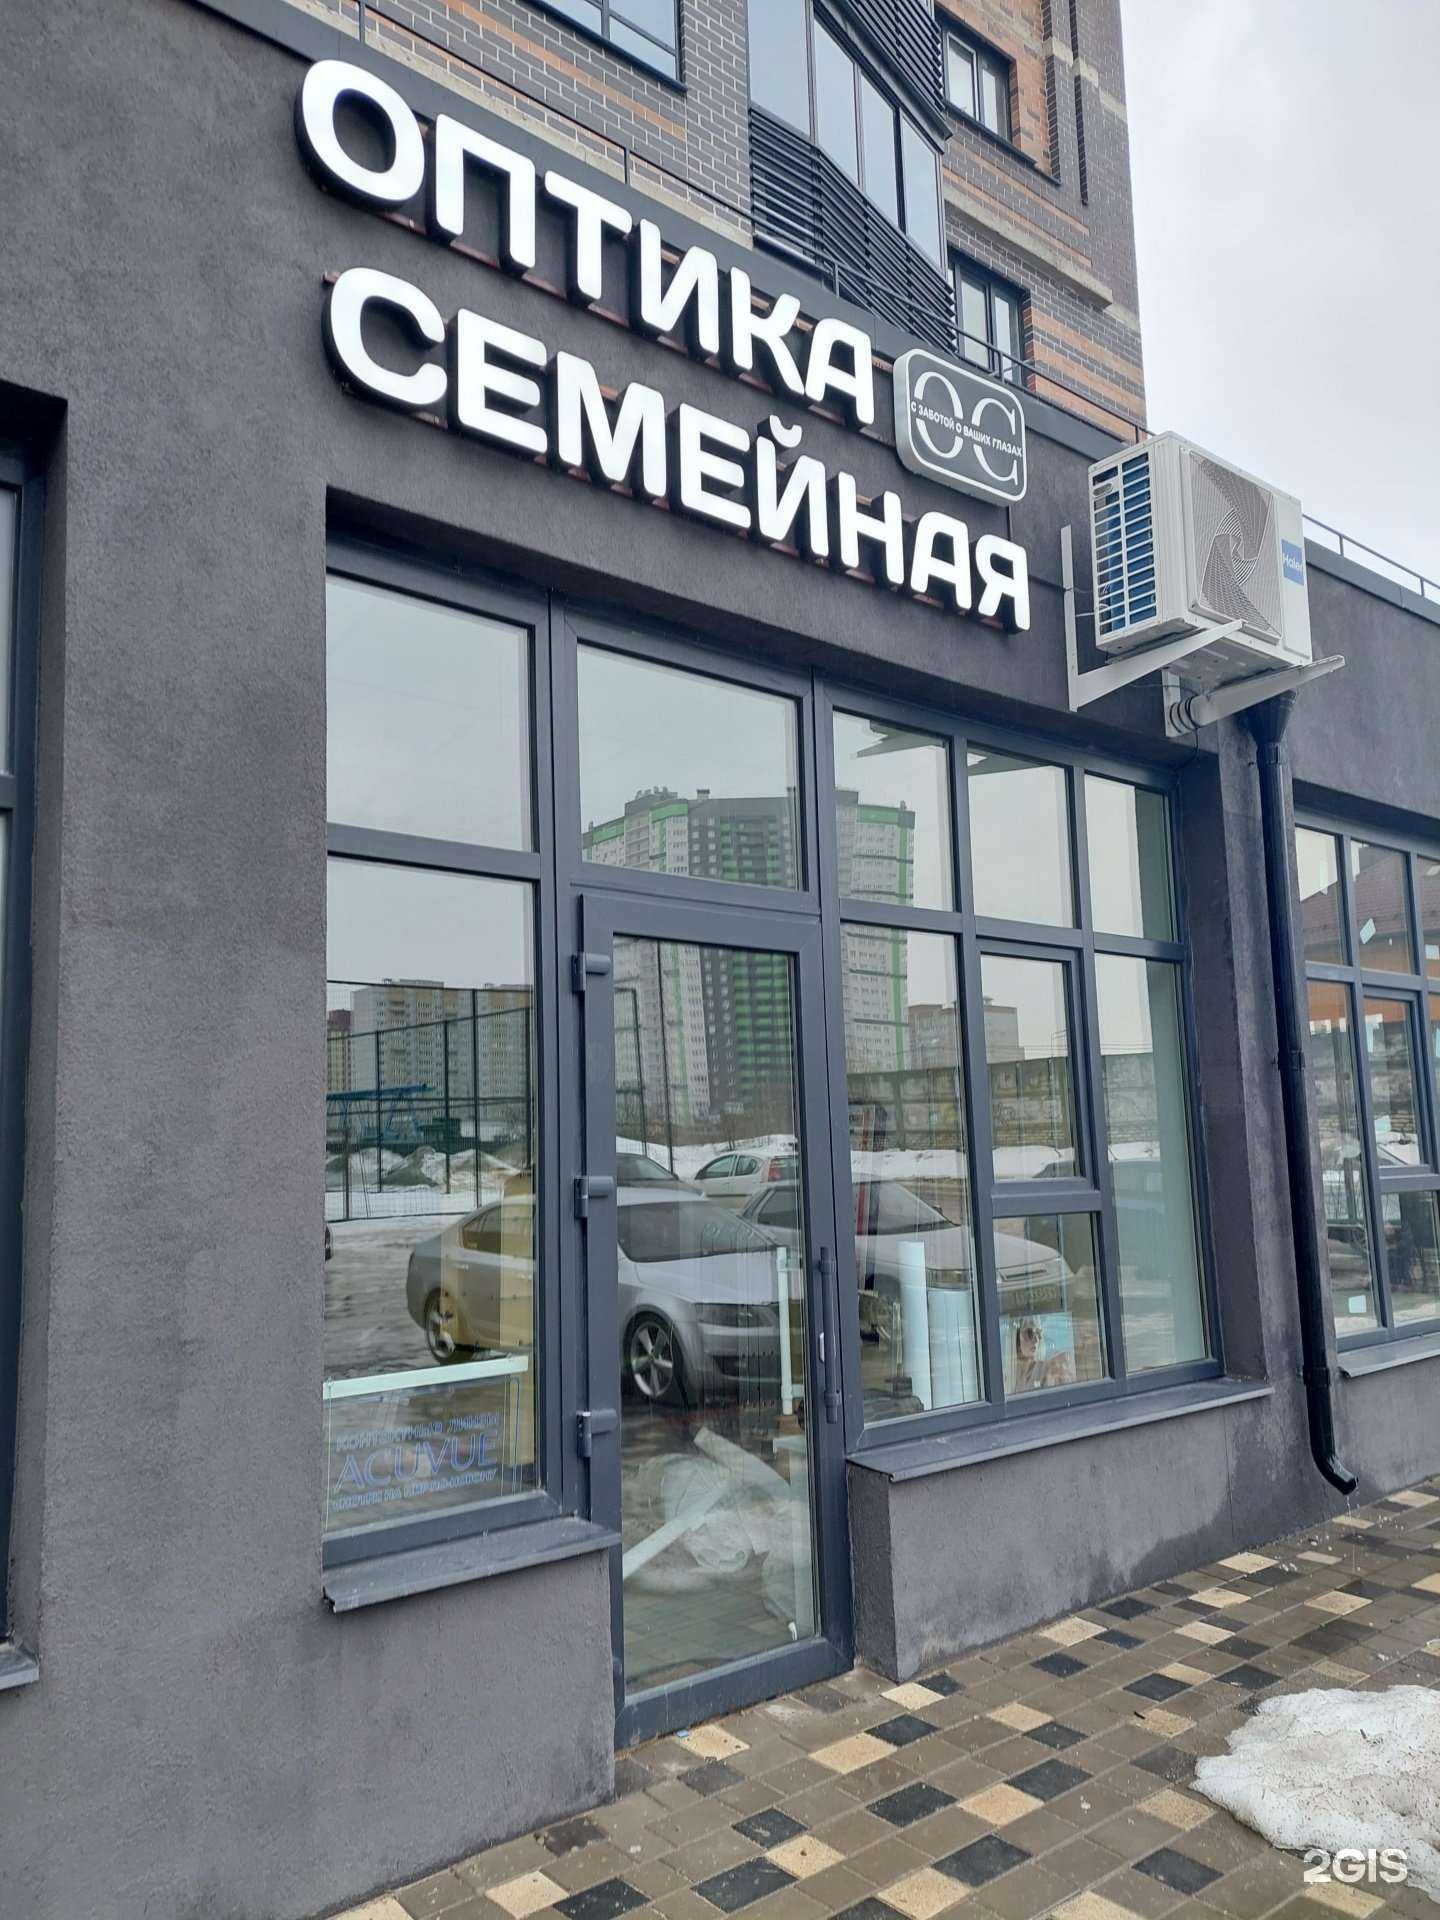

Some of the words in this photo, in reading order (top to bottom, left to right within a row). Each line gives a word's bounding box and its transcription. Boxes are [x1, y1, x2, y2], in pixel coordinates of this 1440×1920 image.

[302, 59, 875, 425] ОПТИКА
[330, 267, 1030, 631] СЕМЕЙНАЯ
[911, 401, 917, 412] С
[918, 405, 955, 430] ЗАБОТОЙ
[956, 422, 962, 433] О
[963, 423, 991, 446] ВАШИХ
[992, 438, 1023, 457] ГЛАЗАХ
[335, 1430, 498, 1489] ACUVUE
